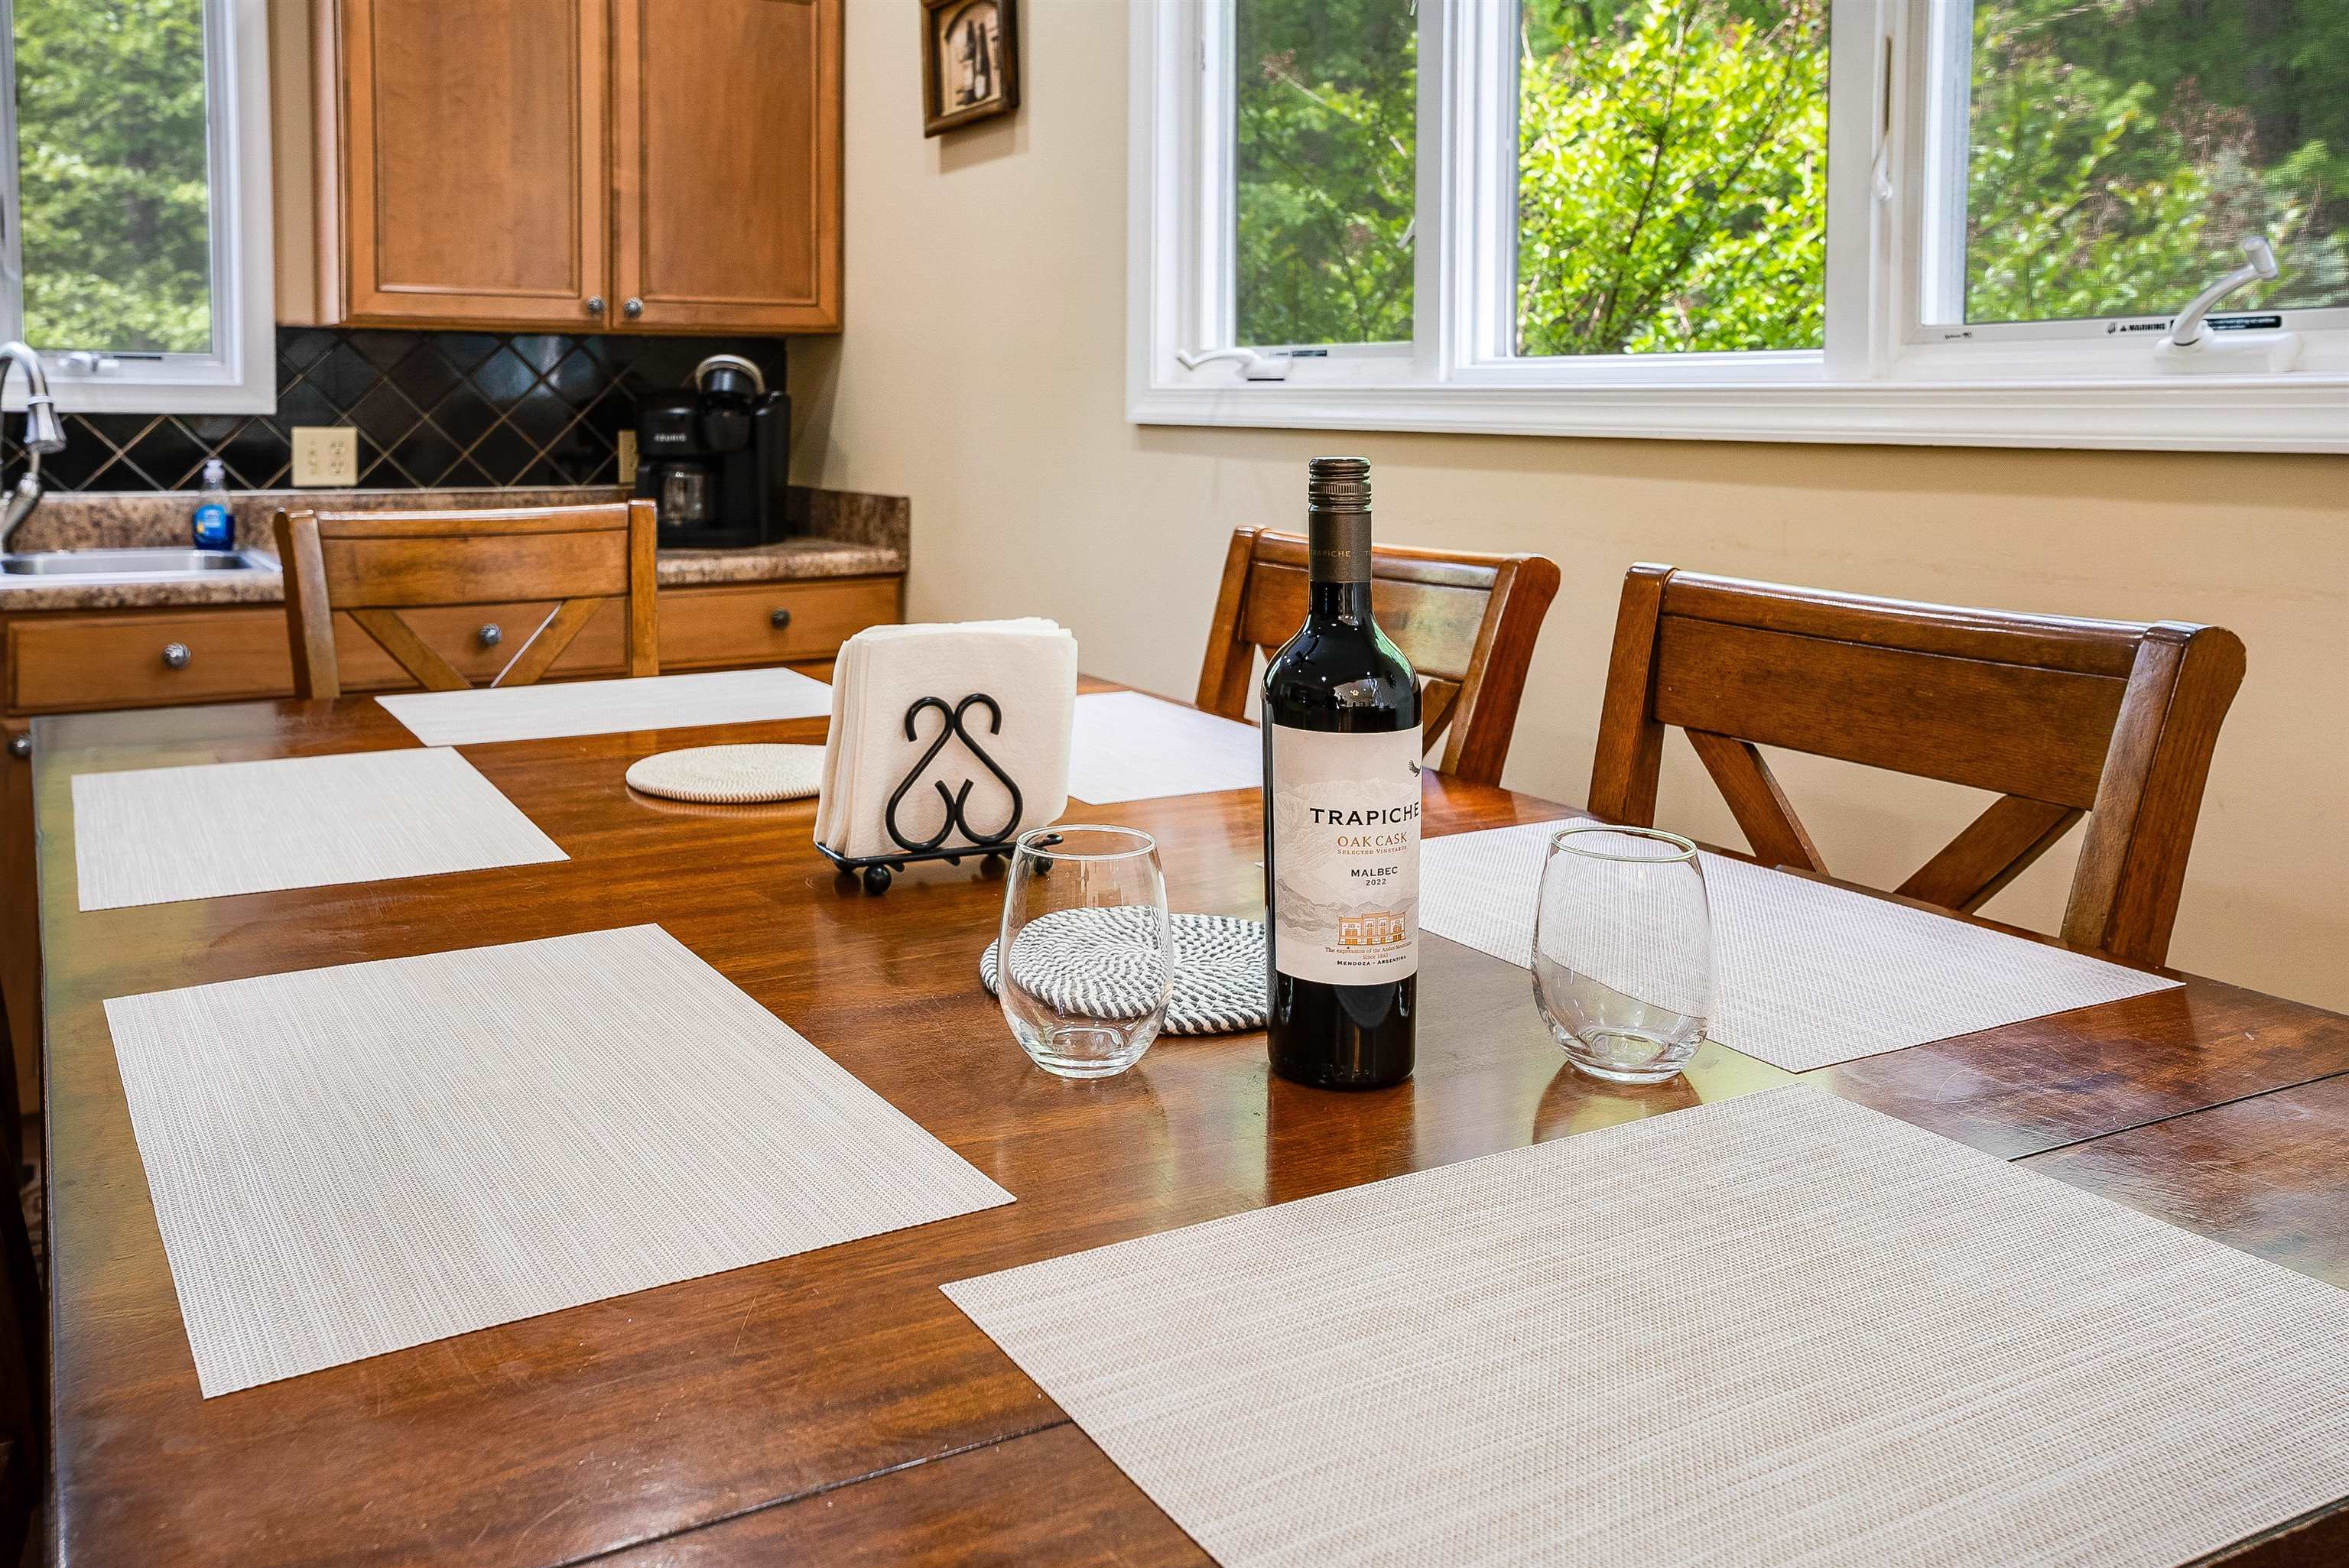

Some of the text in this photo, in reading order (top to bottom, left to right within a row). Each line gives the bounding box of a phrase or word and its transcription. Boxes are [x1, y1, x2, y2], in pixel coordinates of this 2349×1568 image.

[1309, 800, 1419, 826] TRAPICHE
[1337, 832, 1407, 848] OAK CASK
[1350, 866, 1399, 877] MALBEC
[1377, 955, 1407, 965] ARGENTINA
